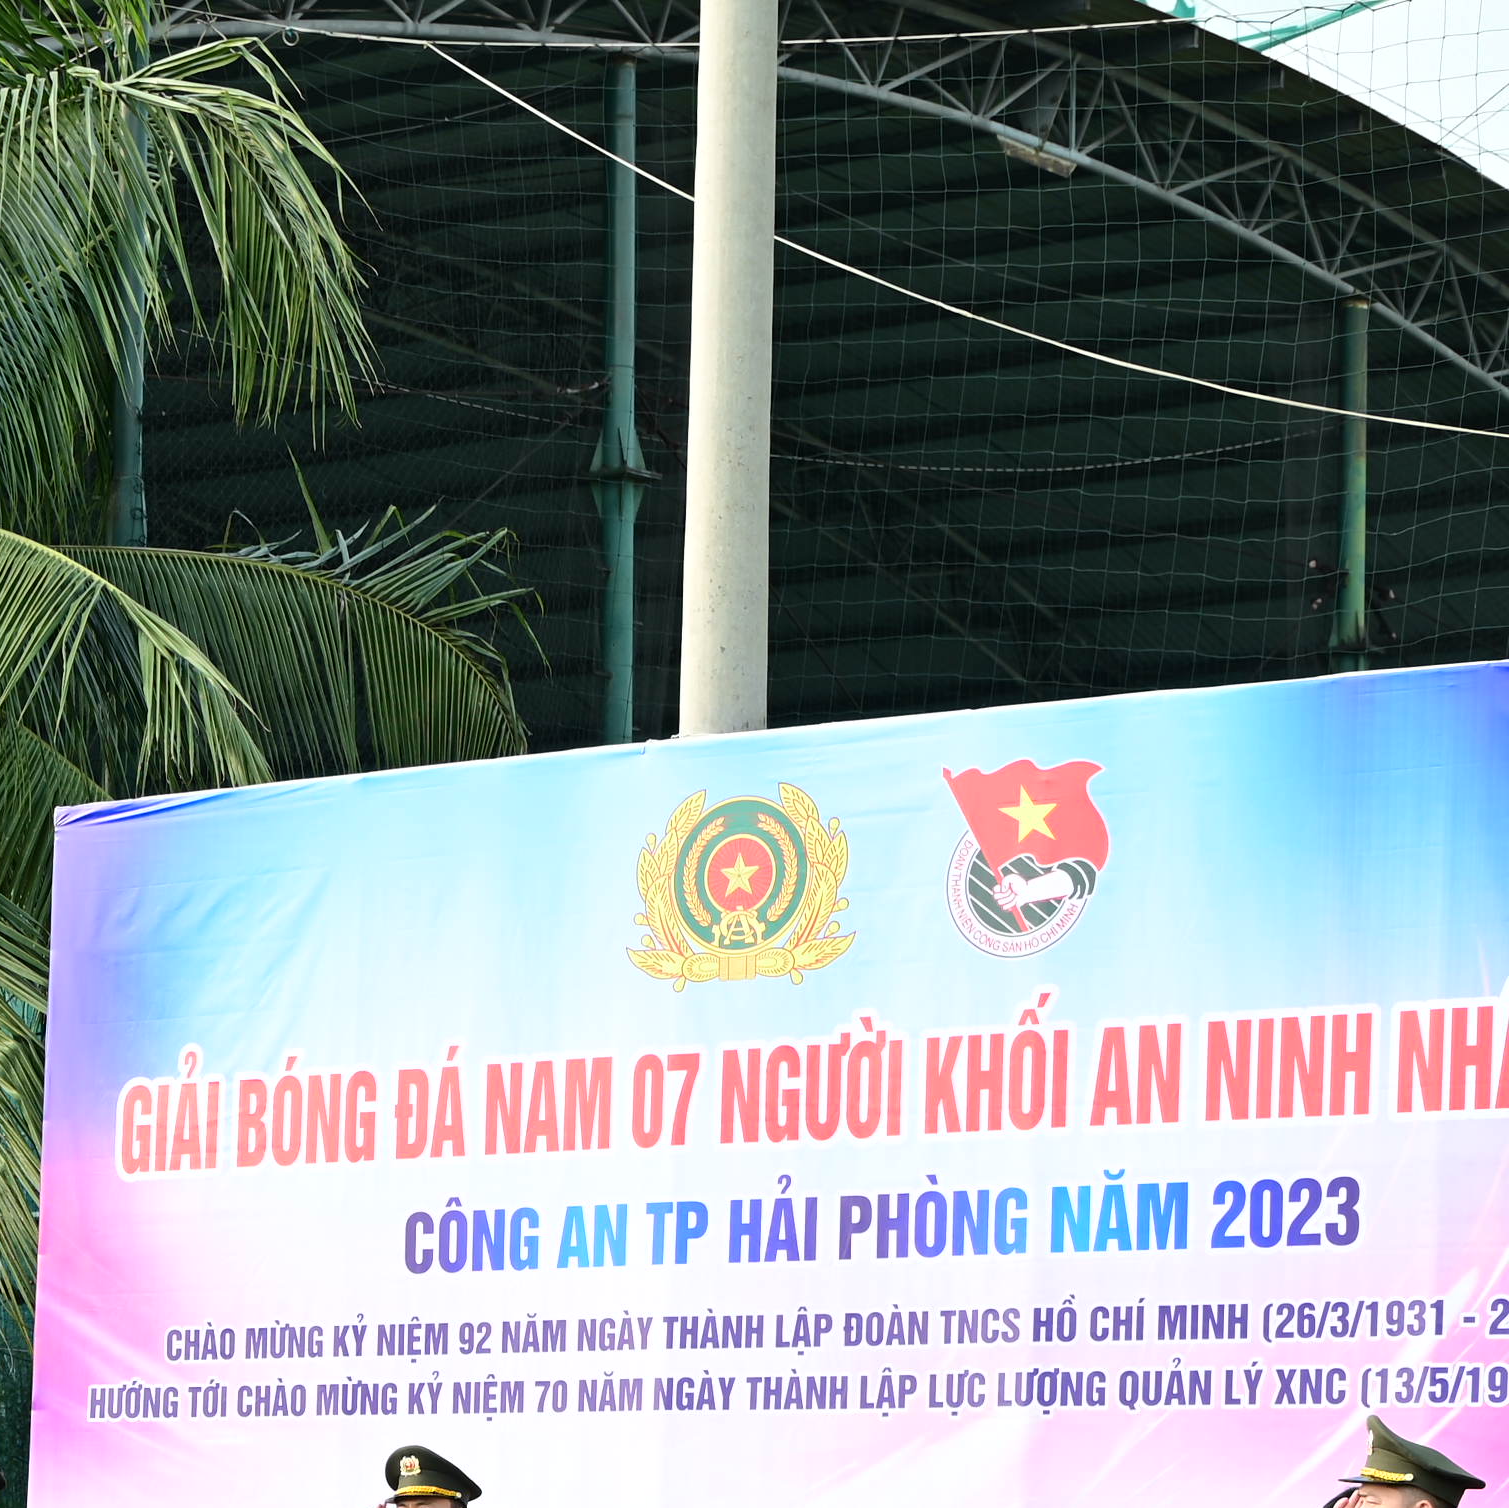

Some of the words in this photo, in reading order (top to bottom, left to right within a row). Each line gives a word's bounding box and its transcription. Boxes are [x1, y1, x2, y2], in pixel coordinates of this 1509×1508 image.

[121, 1050, 221, 1175] GIẢI
[236, 1055, 377, 1168] BÓNG
[394, 1045, 466, 1160] ĐÁ
[484, 1056, 613, 1156] NAM
[631, 1053, 701, 1149] 07
[719, 1016, 904, 1144] NGƯỜI
[924, 992, 1070, 1135] KHỐI
[1089, 1022, 1183, 1127] AN
[1204, 1012, 1373, 1122] NINH
[404, 1196, 540, 1275] CÔNG
[556, 1203, 629, 1270] AN
[645, 1200, 709, 1266] TP
[727, 1174, 819, 1264] HẢI
[838, 1173, 1029, 1261] PHÒNG
[1050, 1168, 1189, 1253] NĂM
[1209, 1175, 1361, 1250] 2023
[165, 1321, 236, 1361] CHÀO
[244, 1319, 324, 1360] MỪNG
[332, 1313, 368, 1358] KỶ
[376, 1316, 450, 1364] NIỆM
[458, 1321, 493, 1355] 92
[501, 1312, 568, 1354] NĂM
[576, 1310, 654, 1352] NGÀY
[662, 1308, 765, 1350] THÀNH
[775, 1306, 833, 1356] LẬP
[842, 1304, 929, 1347] ĐOÀN
[939, 1307, 1021, 1345] TNCS
[1032, 1294, 1078, 1343] HỒ
[1089, 1297, 1146, 1342] CHÍ
[1157, 1303, 1249, 1340] MINH
[1262, 1299, 1445, 1343] (26/3/1931
[89, 1380, 179, 1419] HƯỚNG
[188, 1379, 228, 1418] TỚI
[236, 1377, 307, 1417] CHÀO
[316, 1376, 398, 1416] MỪNG
[407, 1371, 443, 1415] KỶ
[452, 1373, 525, 1422] NIỆM
[534, 1380, 568, 1413] 70
[577, 1371, 644, 1413] NĂM
[652, 1369, 736, 1411] NGÀY
[746, 1368, 849, 1410] THÀNH
[859, 1366, 918, 1417] LẬP
[928, 1369, 986, 1416] LỰC
[996, 1368, 1107, 1415] LƯỢNG
[1118, 1357, 1213, 1411] QUẢN
[1224, 1361, 1264, 1406] LÝ
[1274, 1367, 1347, 1406] XNC
